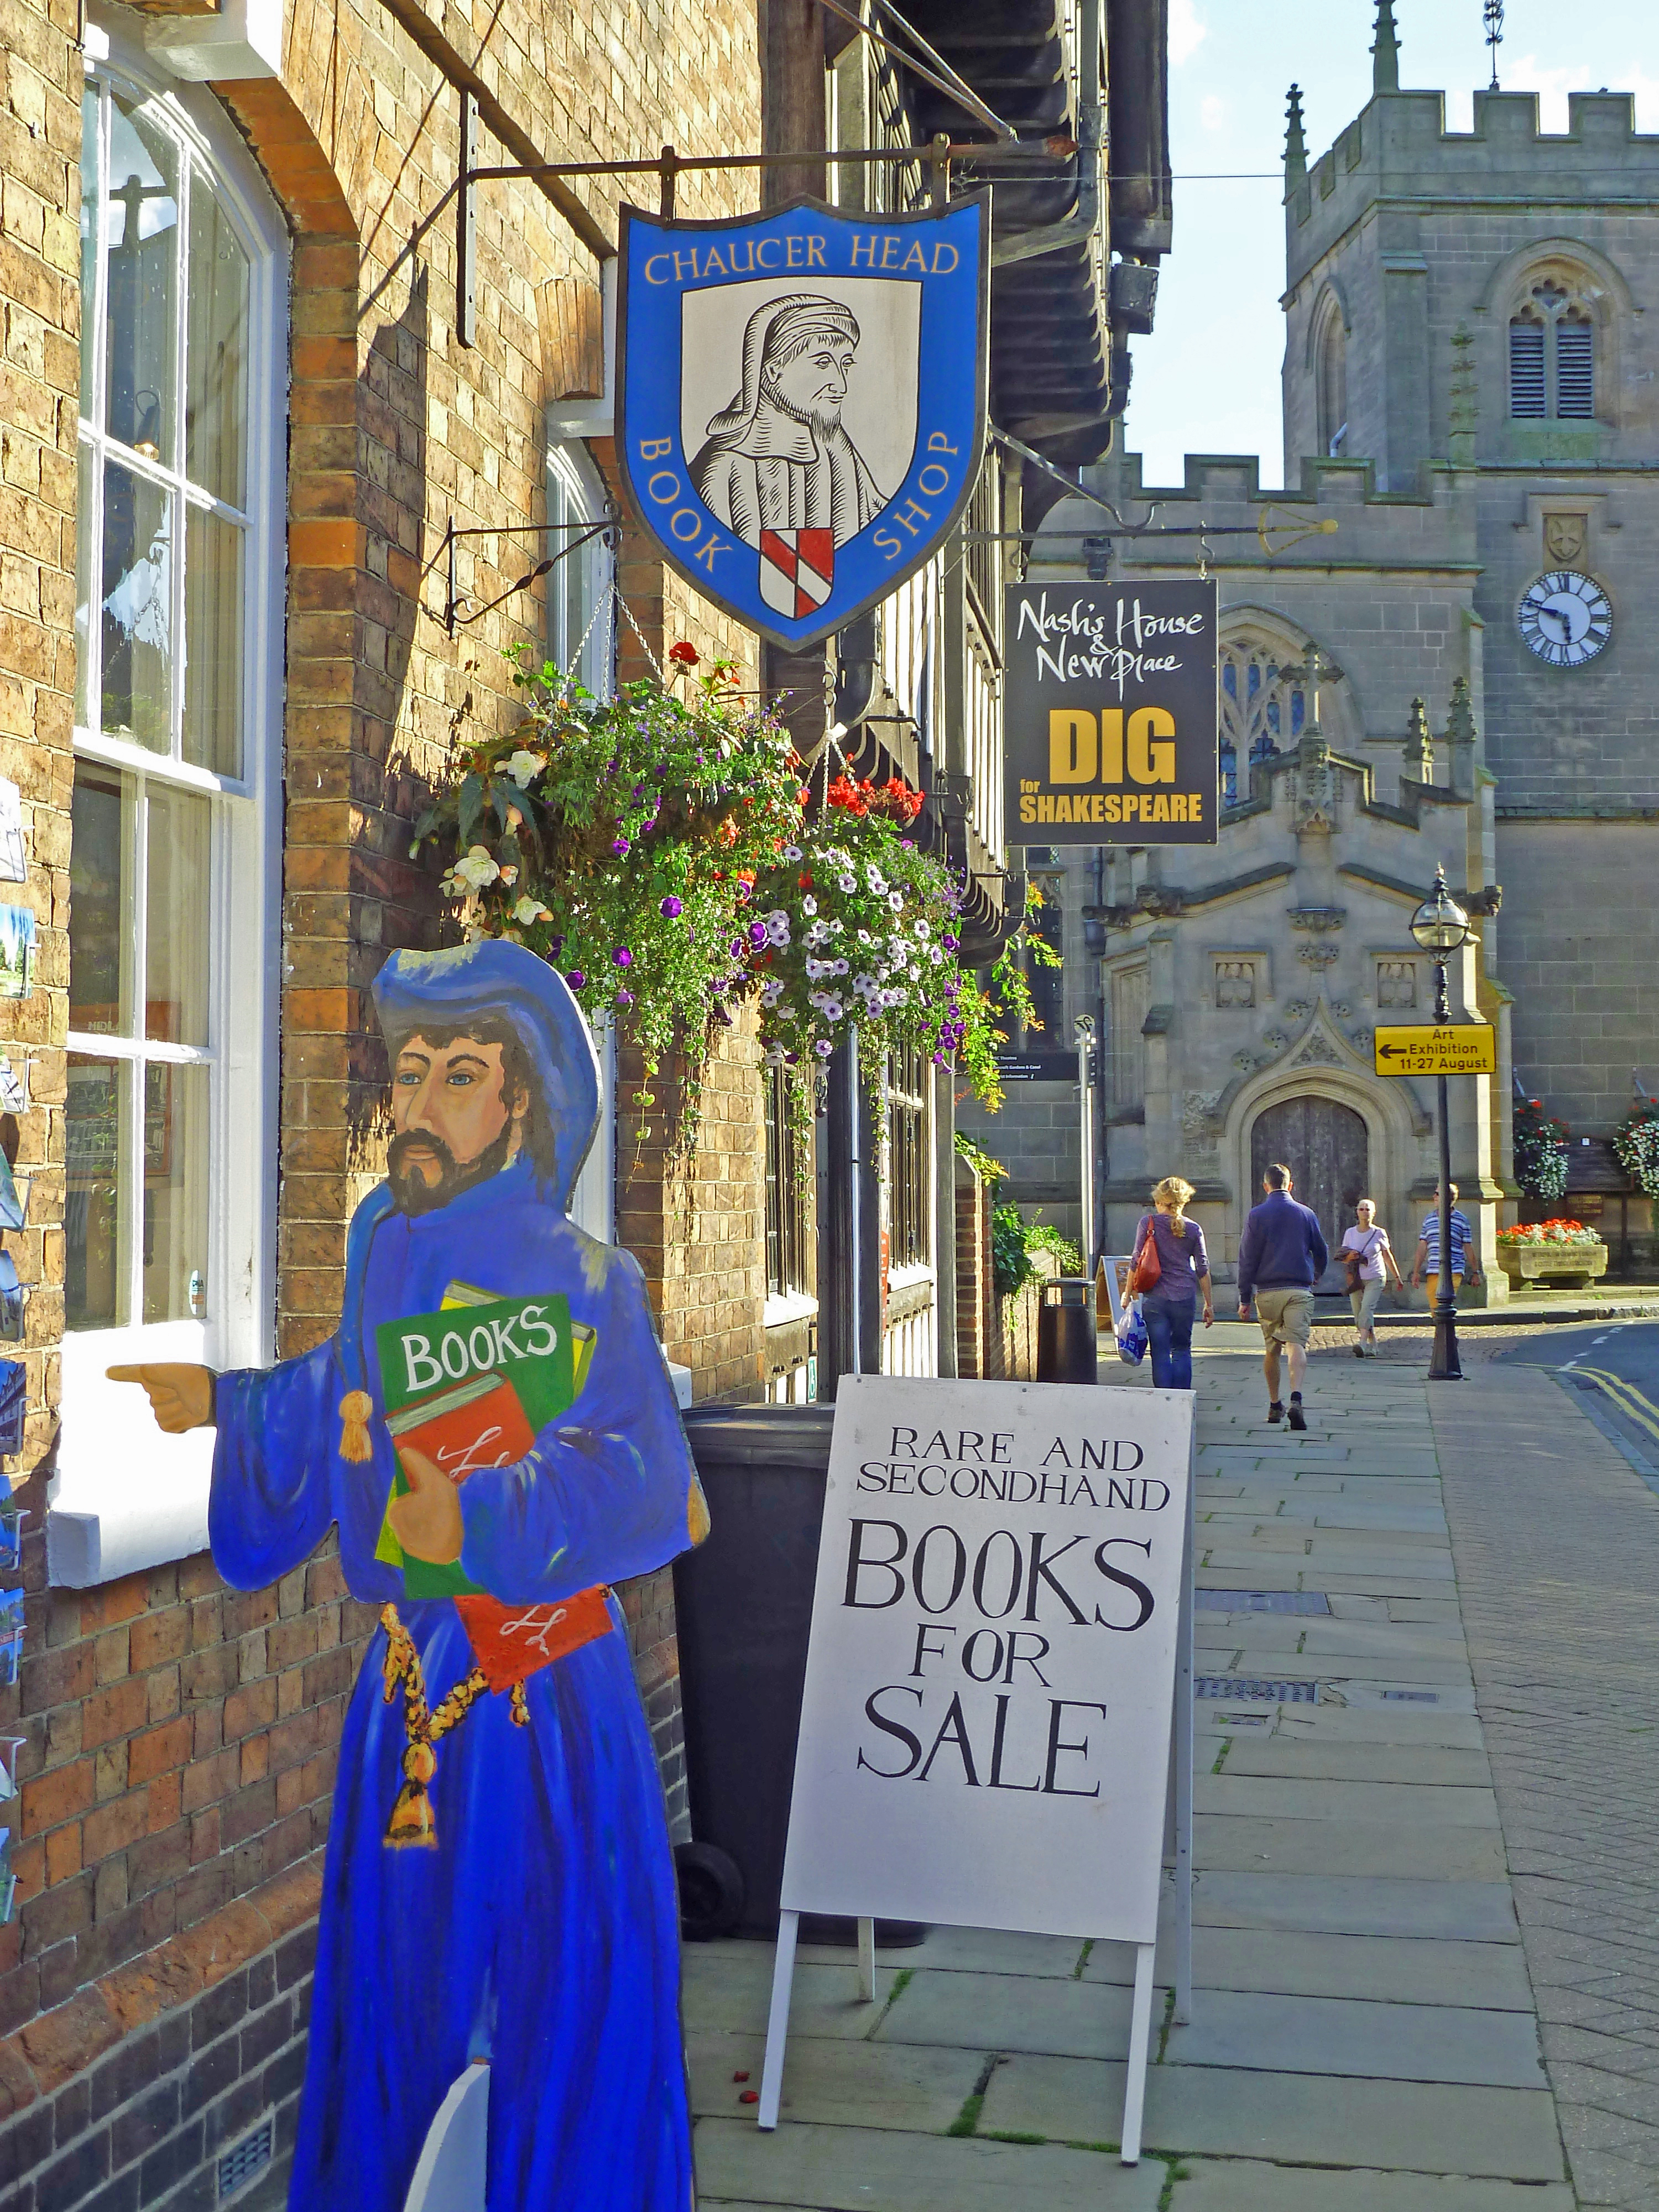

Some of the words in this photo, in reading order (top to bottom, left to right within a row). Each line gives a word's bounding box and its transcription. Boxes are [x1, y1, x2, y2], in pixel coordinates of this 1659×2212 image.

[645, 236, 826, 284] CHAUCER
[851, 236, 959, 274] HEAD
[640, 437, 734, 572] BOOK
[874, 431, 958, 560] SHOP
[1017, 591, 1105, 642] Nash's
[1115, 598, 1204, 648] House
[1089, 634, 1119, 655] &
[1036, 635, 1108, 682] New
[1110, 648, 1182, 702] Place
[1049, 706, 1176, 784] DIG
[1019, 794, 1202, 823] SHAKESPEARE
[1020, 778, 1040, 793] for
[1410, 1043, 1478, 1054] Exhibition
[1432, 1029, 1454, 1040] Art
[1400, 1058, 1433, 1069] 11-27
[1439, 1057, 1488, 1070] August
[400, 1305, 557, 1392] BOOKS
[889, 1427, 1015, 1463] RARE
[1039, 1437, 1144, 1471] AND
[856, 1462, 1170, 1511] SECONDHAND
[841, 1518, 1155, 1632] BOOKS
[907, 1623, 1052, 1687] FOR
[857, 1685, 1107, 1798] SALE
